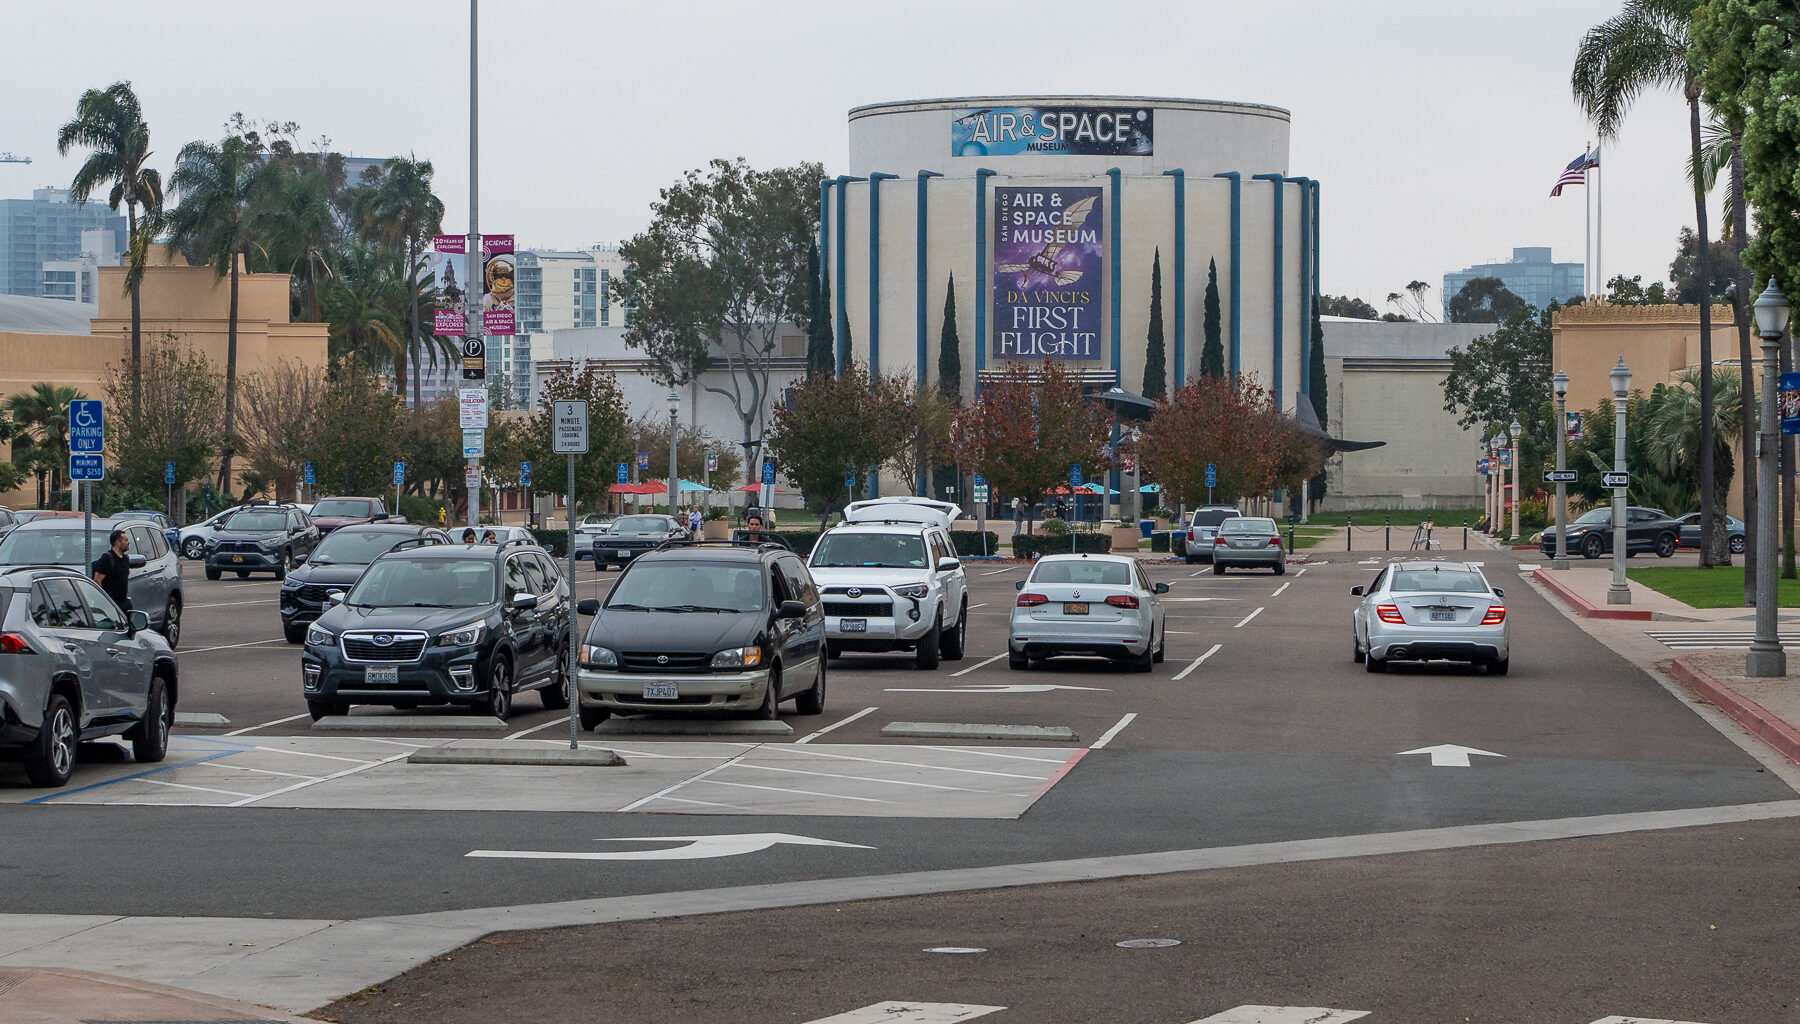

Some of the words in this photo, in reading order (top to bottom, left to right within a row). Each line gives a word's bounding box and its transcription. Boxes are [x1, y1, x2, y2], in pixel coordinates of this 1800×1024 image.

[972, 113, 1018, 143] AIR
[1020, 113, 1036, 138] &
[1039, 112, 1133, 143] SPACE
[1026, 142, 1070, 152] MUSEUM
[1013, 193, 1044, 207] AIR
[1050, 193, 1062, 207] &
[1013, 211, 1073, 226] SPACE
[1013, 229, 1097, 244] MUSEUM
[1007, 290, 1028, 304] DA
[1034, 290, 1090, 304] VINCI'S
[1013, 306, 1085, 330] FIRST
[470, 341, 478, 354] P
[1000, 332, 1096, 355] FLIGHT
[567, 405, 573, 415] 3
[560, 417, 581, 425] MINUTE
[71, 427, 102, 437] PARKING
[77, 439, 96, 449] ONLY
[75, 459, 98, 467] MINIMUM
[86, 468, 101, 476] $250
